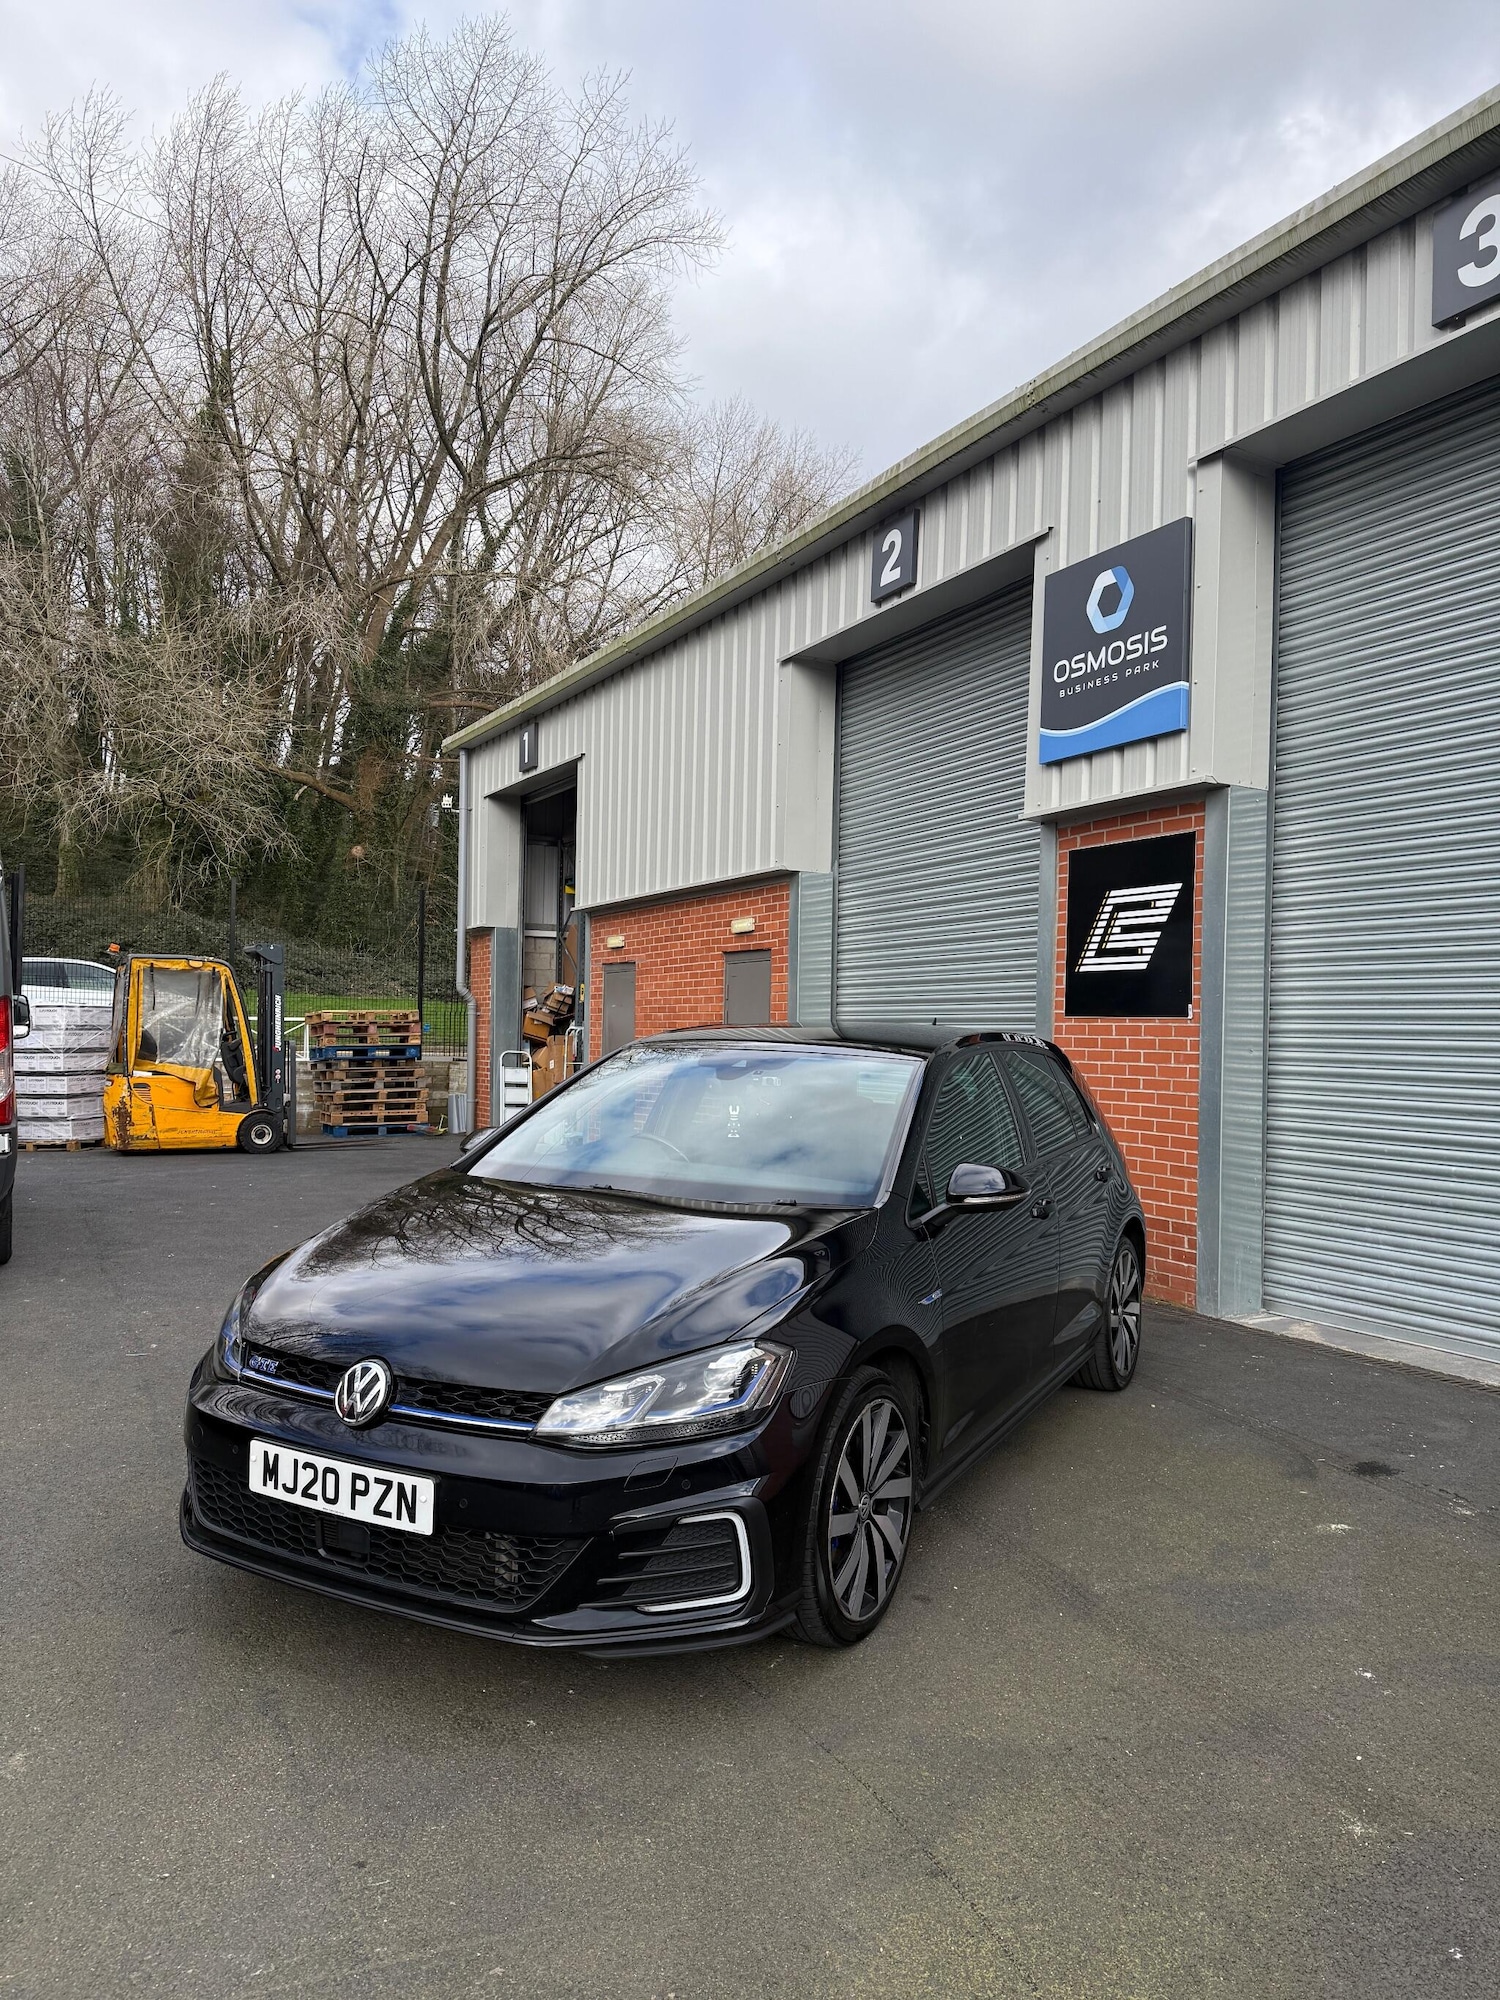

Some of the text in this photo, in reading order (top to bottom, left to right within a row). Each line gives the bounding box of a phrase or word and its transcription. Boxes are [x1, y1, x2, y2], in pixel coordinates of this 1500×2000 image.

[1457, 193, 1500, 288] 3
[880, 528, 902, 588] 2
[1053, 624, 1168, 683] OSMOSIS
[1059, 659, 1160, 698] BUSINESS PARK
[522, 731, 529, 764] 1
[274, 994, 282, 1052] JUNGHEINRICH
[250, 1355, 279, 1374] GTE
[262, 1450, 417, 1524] MJ20 PZN
